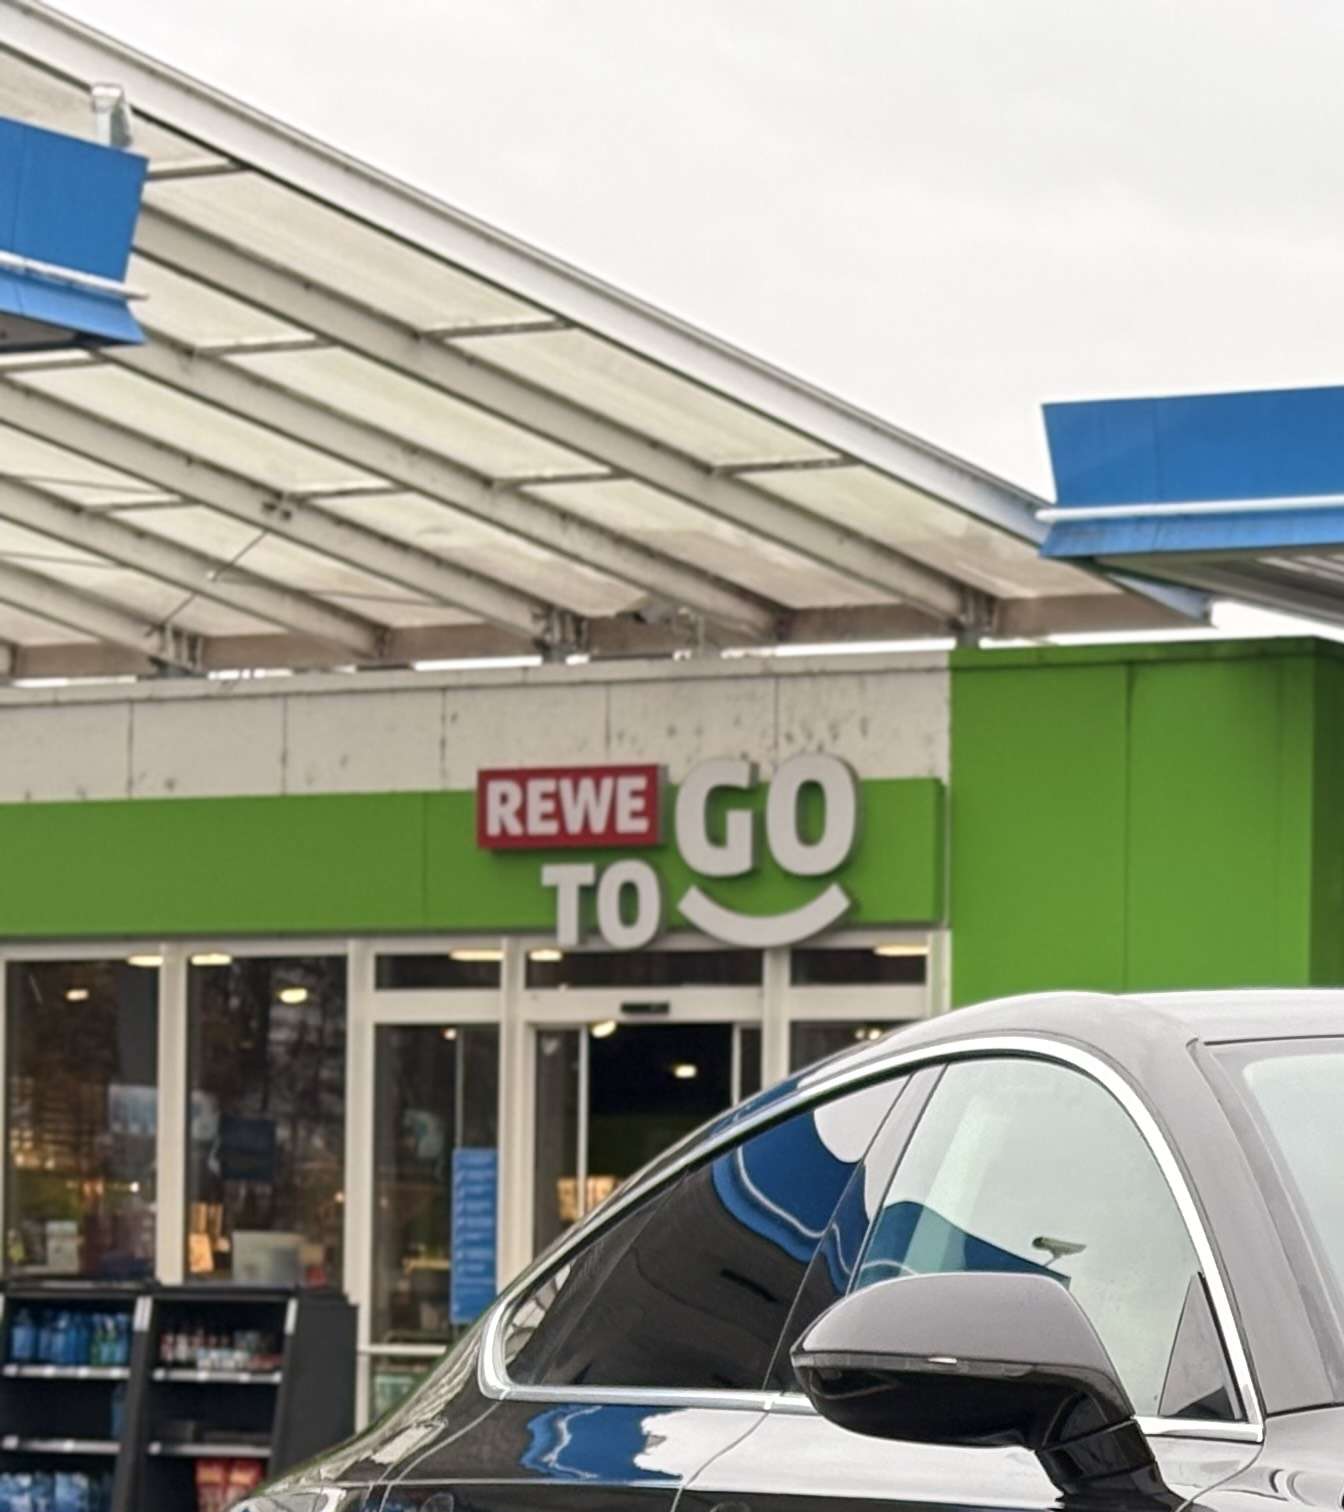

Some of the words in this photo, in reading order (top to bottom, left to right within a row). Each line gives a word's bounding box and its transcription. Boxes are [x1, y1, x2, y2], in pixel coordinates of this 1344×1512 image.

[486, 774, 650, 838] REWE
[541, 858, 662, 949] TO
[674, 752, 859, 877] GO
